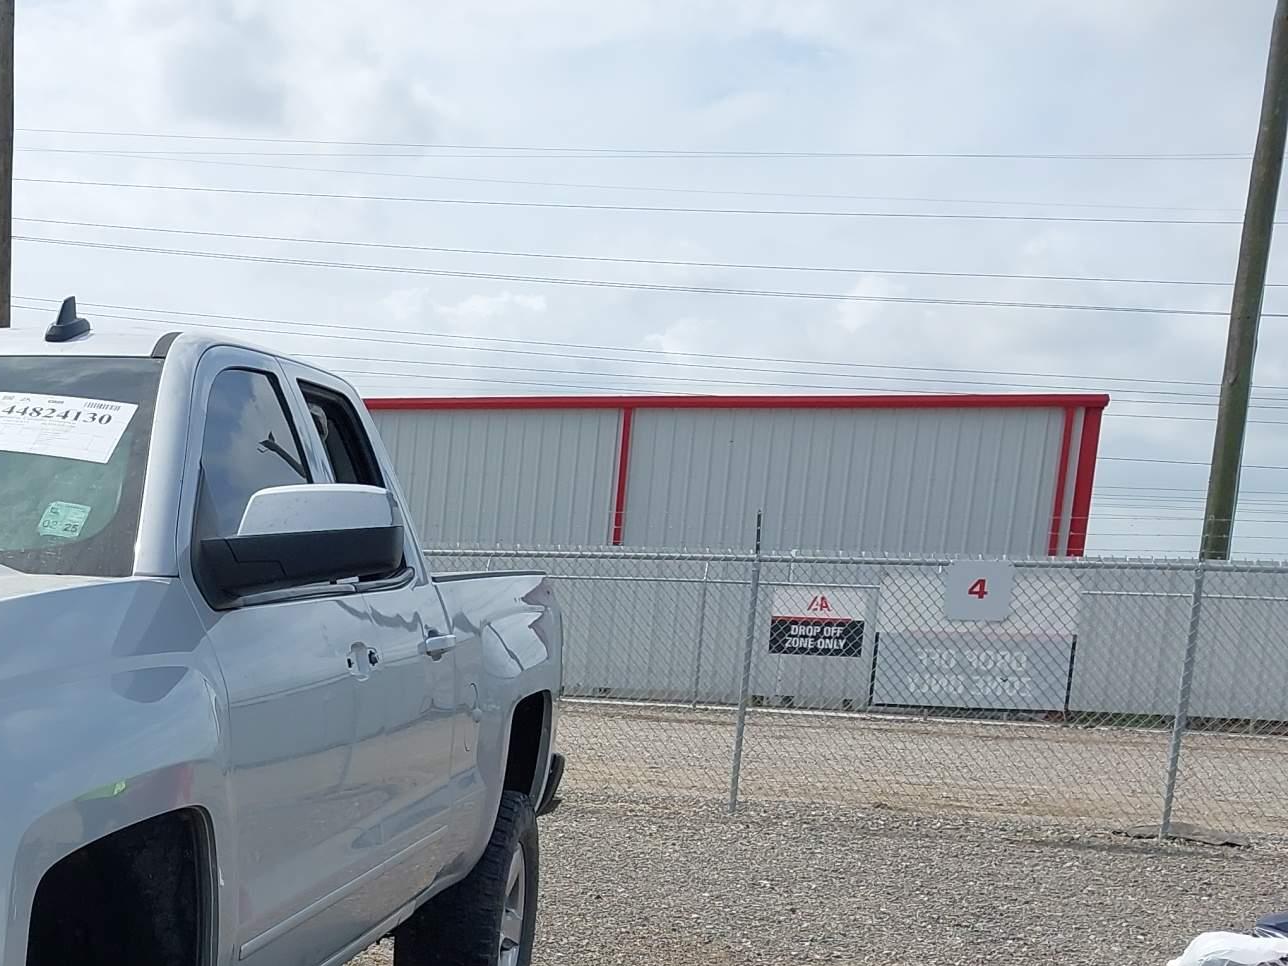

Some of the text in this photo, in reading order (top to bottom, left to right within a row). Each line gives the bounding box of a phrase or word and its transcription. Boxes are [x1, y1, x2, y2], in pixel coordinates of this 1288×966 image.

[2, 404, 113, 425] 44824130
[63, 523, 79, 533] 25
[968, 579, 988, 599] 4
[791, 625, 844, 637] DROP OFF
[785, 637, 846, 650] ZONE ONLY
